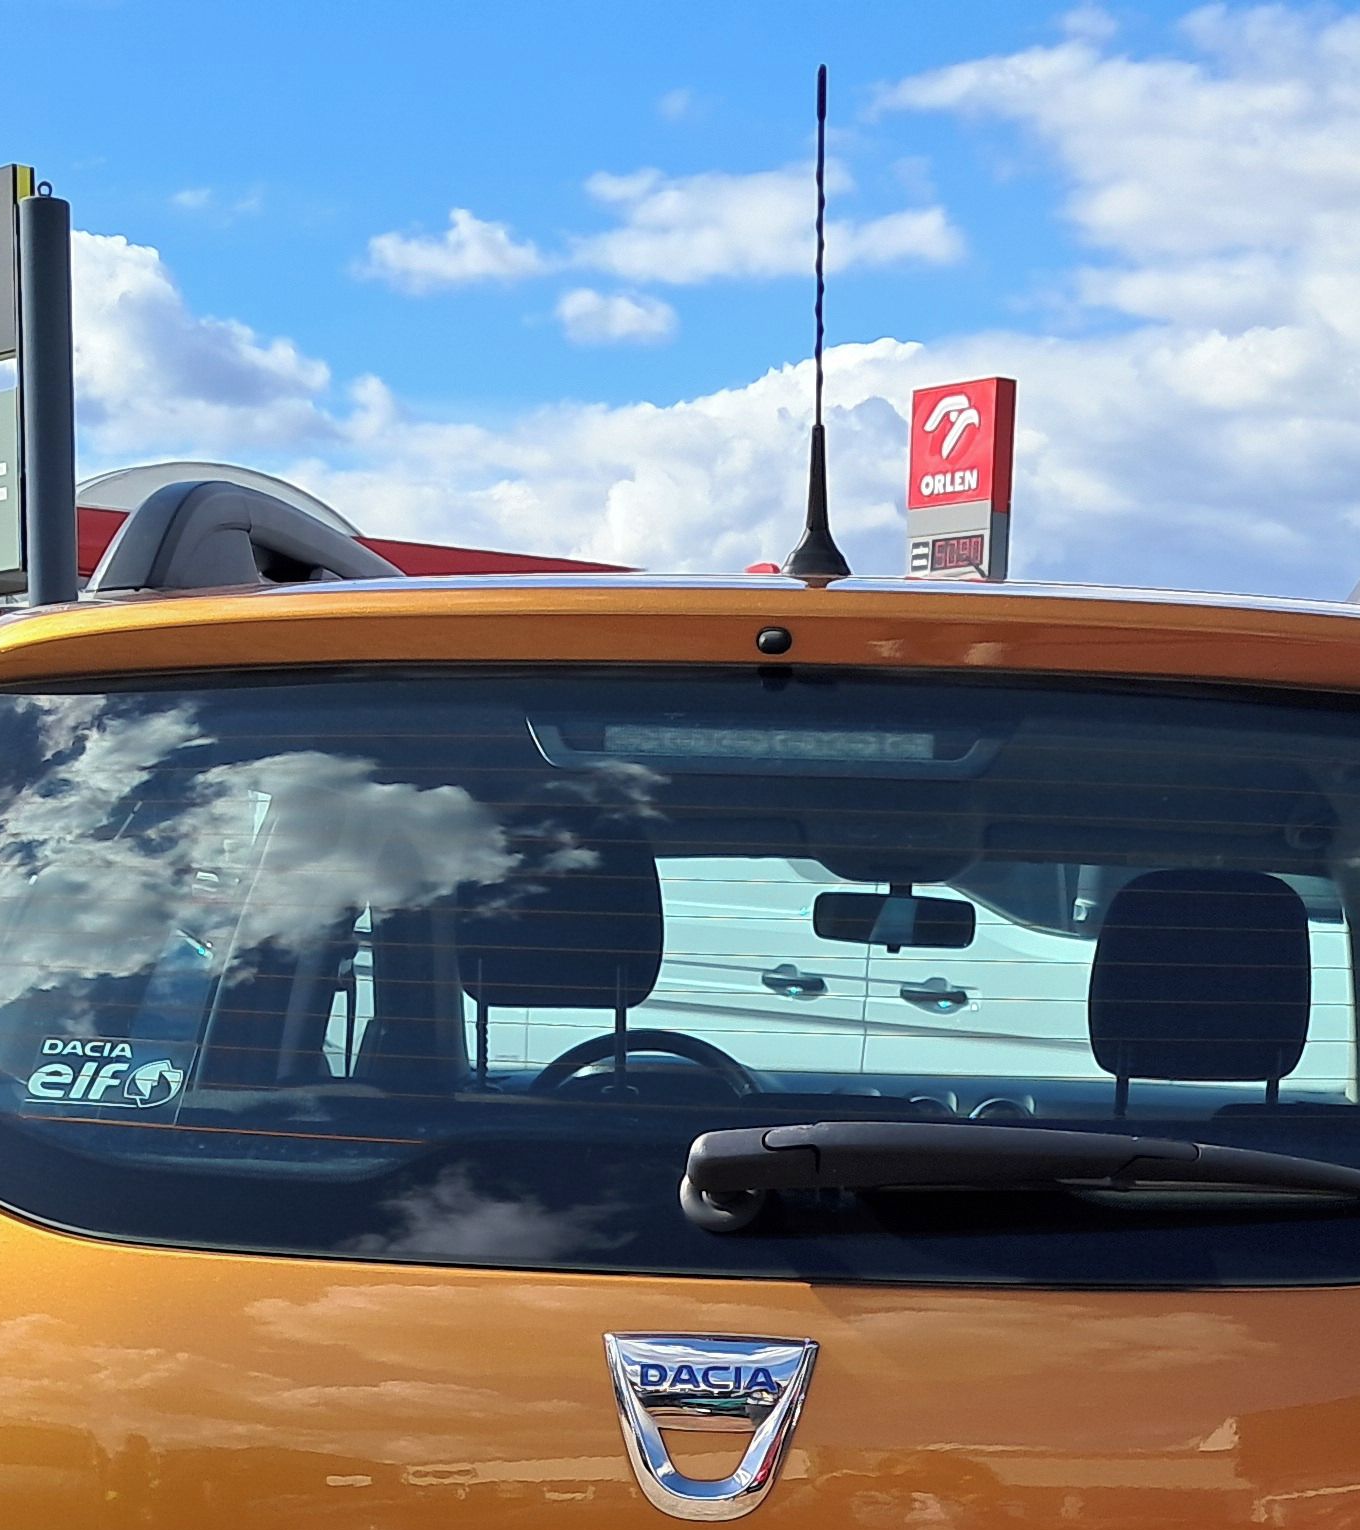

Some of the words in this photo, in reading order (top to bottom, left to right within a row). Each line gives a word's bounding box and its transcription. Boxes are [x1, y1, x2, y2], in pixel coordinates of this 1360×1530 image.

[920, 468, 979, 496] ORLEN
[42, 1039, 133, 1059] DACIA
[27, 1061, 131, 1100] elf
[640, 1363, 779, 1392] DACIA
